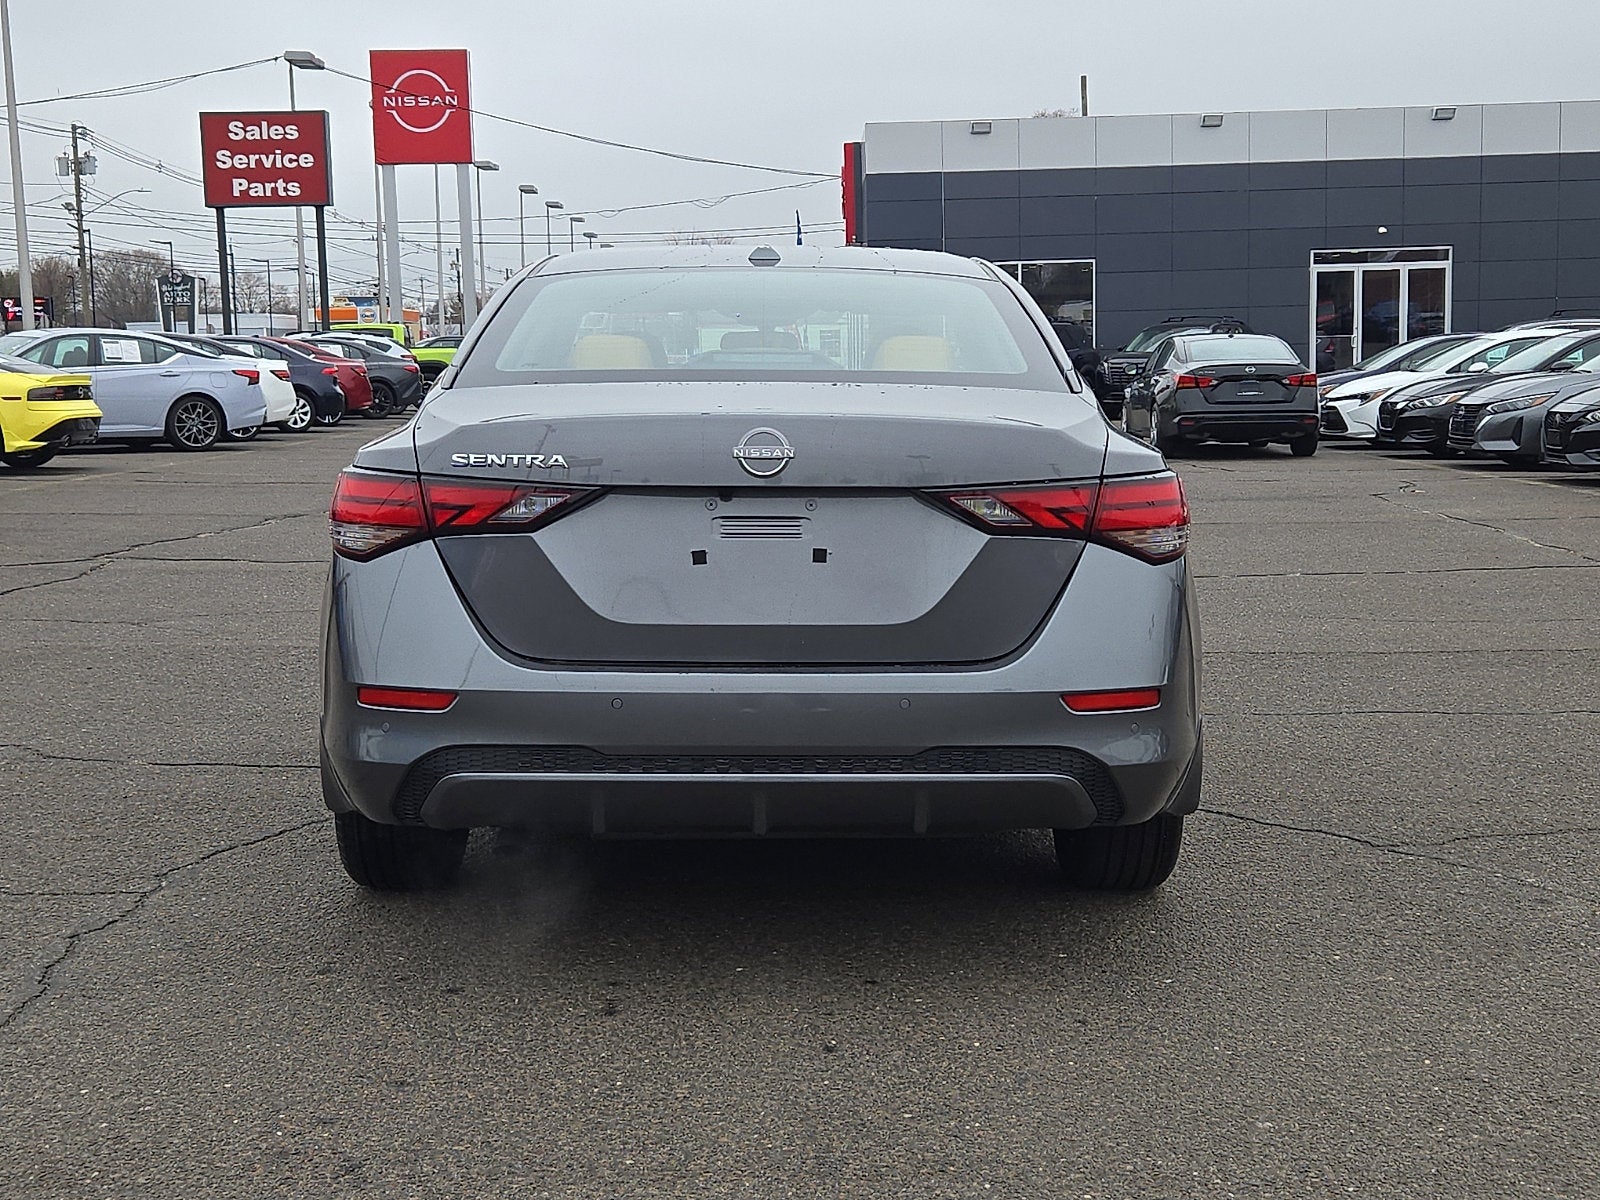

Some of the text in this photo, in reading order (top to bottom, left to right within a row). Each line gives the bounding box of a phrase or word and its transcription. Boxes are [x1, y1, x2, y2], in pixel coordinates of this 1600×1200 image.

[383, 95, 458, 107] NISSAN
[227, 120, 299, 140] Sales
[215, 149, 315, 169] Service
[231, 178, 301, 197] Parts
[450, 453, 569, 468] SENTRA
[733, 448, 794, 457] NISSAN
